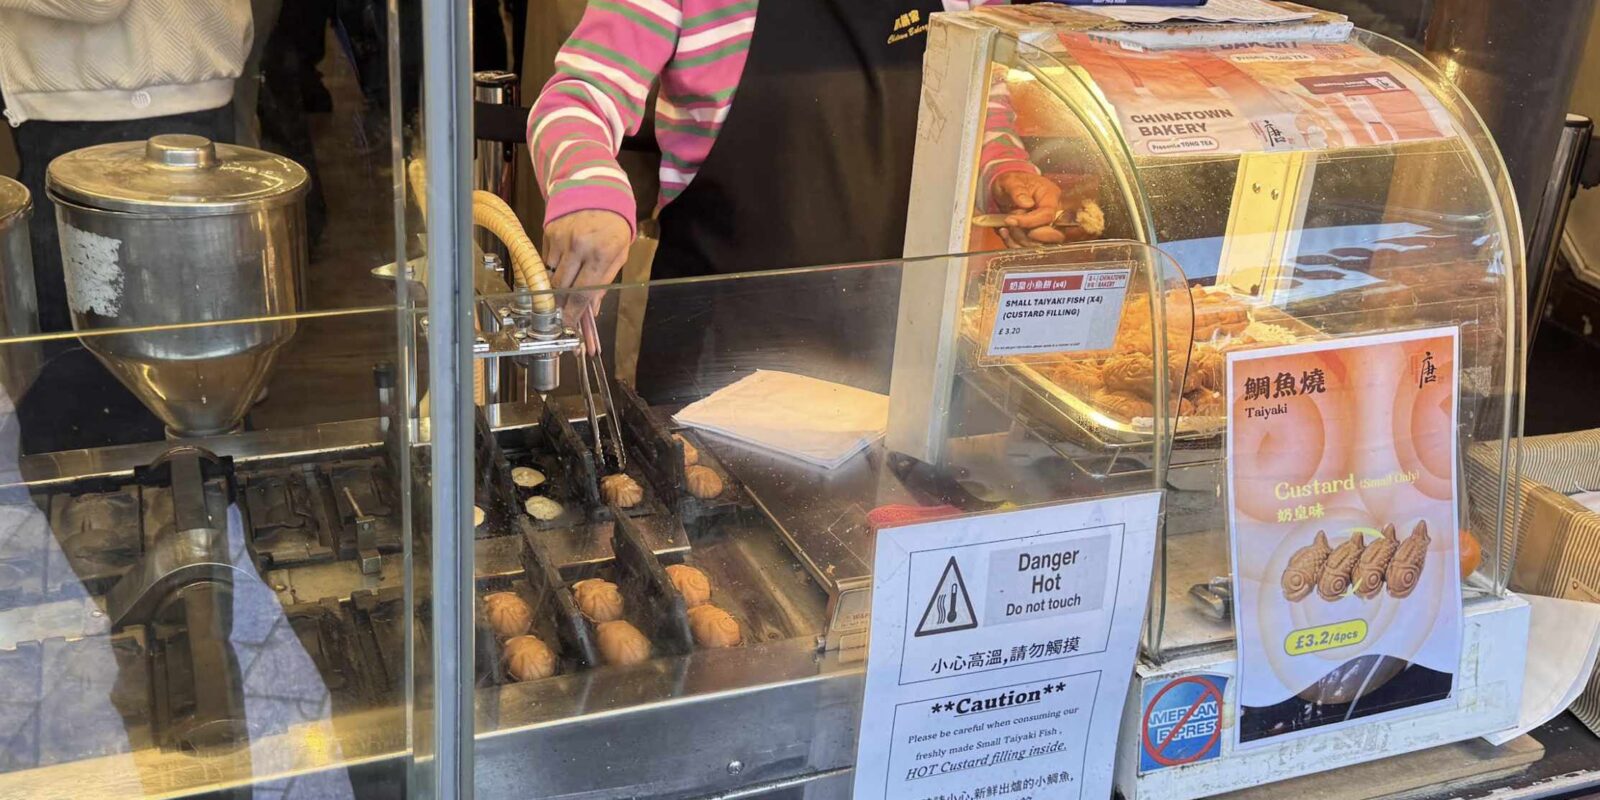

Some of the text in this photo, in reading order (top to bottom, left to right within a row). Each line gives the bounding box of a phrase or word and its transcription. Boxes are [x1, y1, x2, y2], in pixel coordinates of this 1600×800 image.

[1130, 108, 1234, 124] CHINATOWN
[1138, 122, 1208, 137] BAKERY
[1005, 295, 1104, 308] SMALL TAIYAKI FISH (X4)
[1002, 308, 1080, 320] (CUSTARD FILLING)
[1244, 368, 1326, 401] 鯛魚燒
[1245, 403, 1288, 420] Taiyaki
[1274, 473, 1355, 501] Custard
[1276, 502, 1325, 523] 奶皇味
[1018, 549, 1080, 572] Danger
[1031, 573, 1062, 594] Hot
[1006, 593, 1081, 616] Do not touch
[1295, 629, 1359, 651] £3.2/4pcs
[908, 707, 1080, 744] Please be careful when consuming our
[915, 748, 947, 761] freshly
[949, 743, 974, 755] made
[976, 736, 1001, 750] Small
[1003, 730, 1037, 743] Taiyaki
[1038, 727, 1057, 738] Fish
[905, 740, 1067, 780] HOT Custard filling inside.
